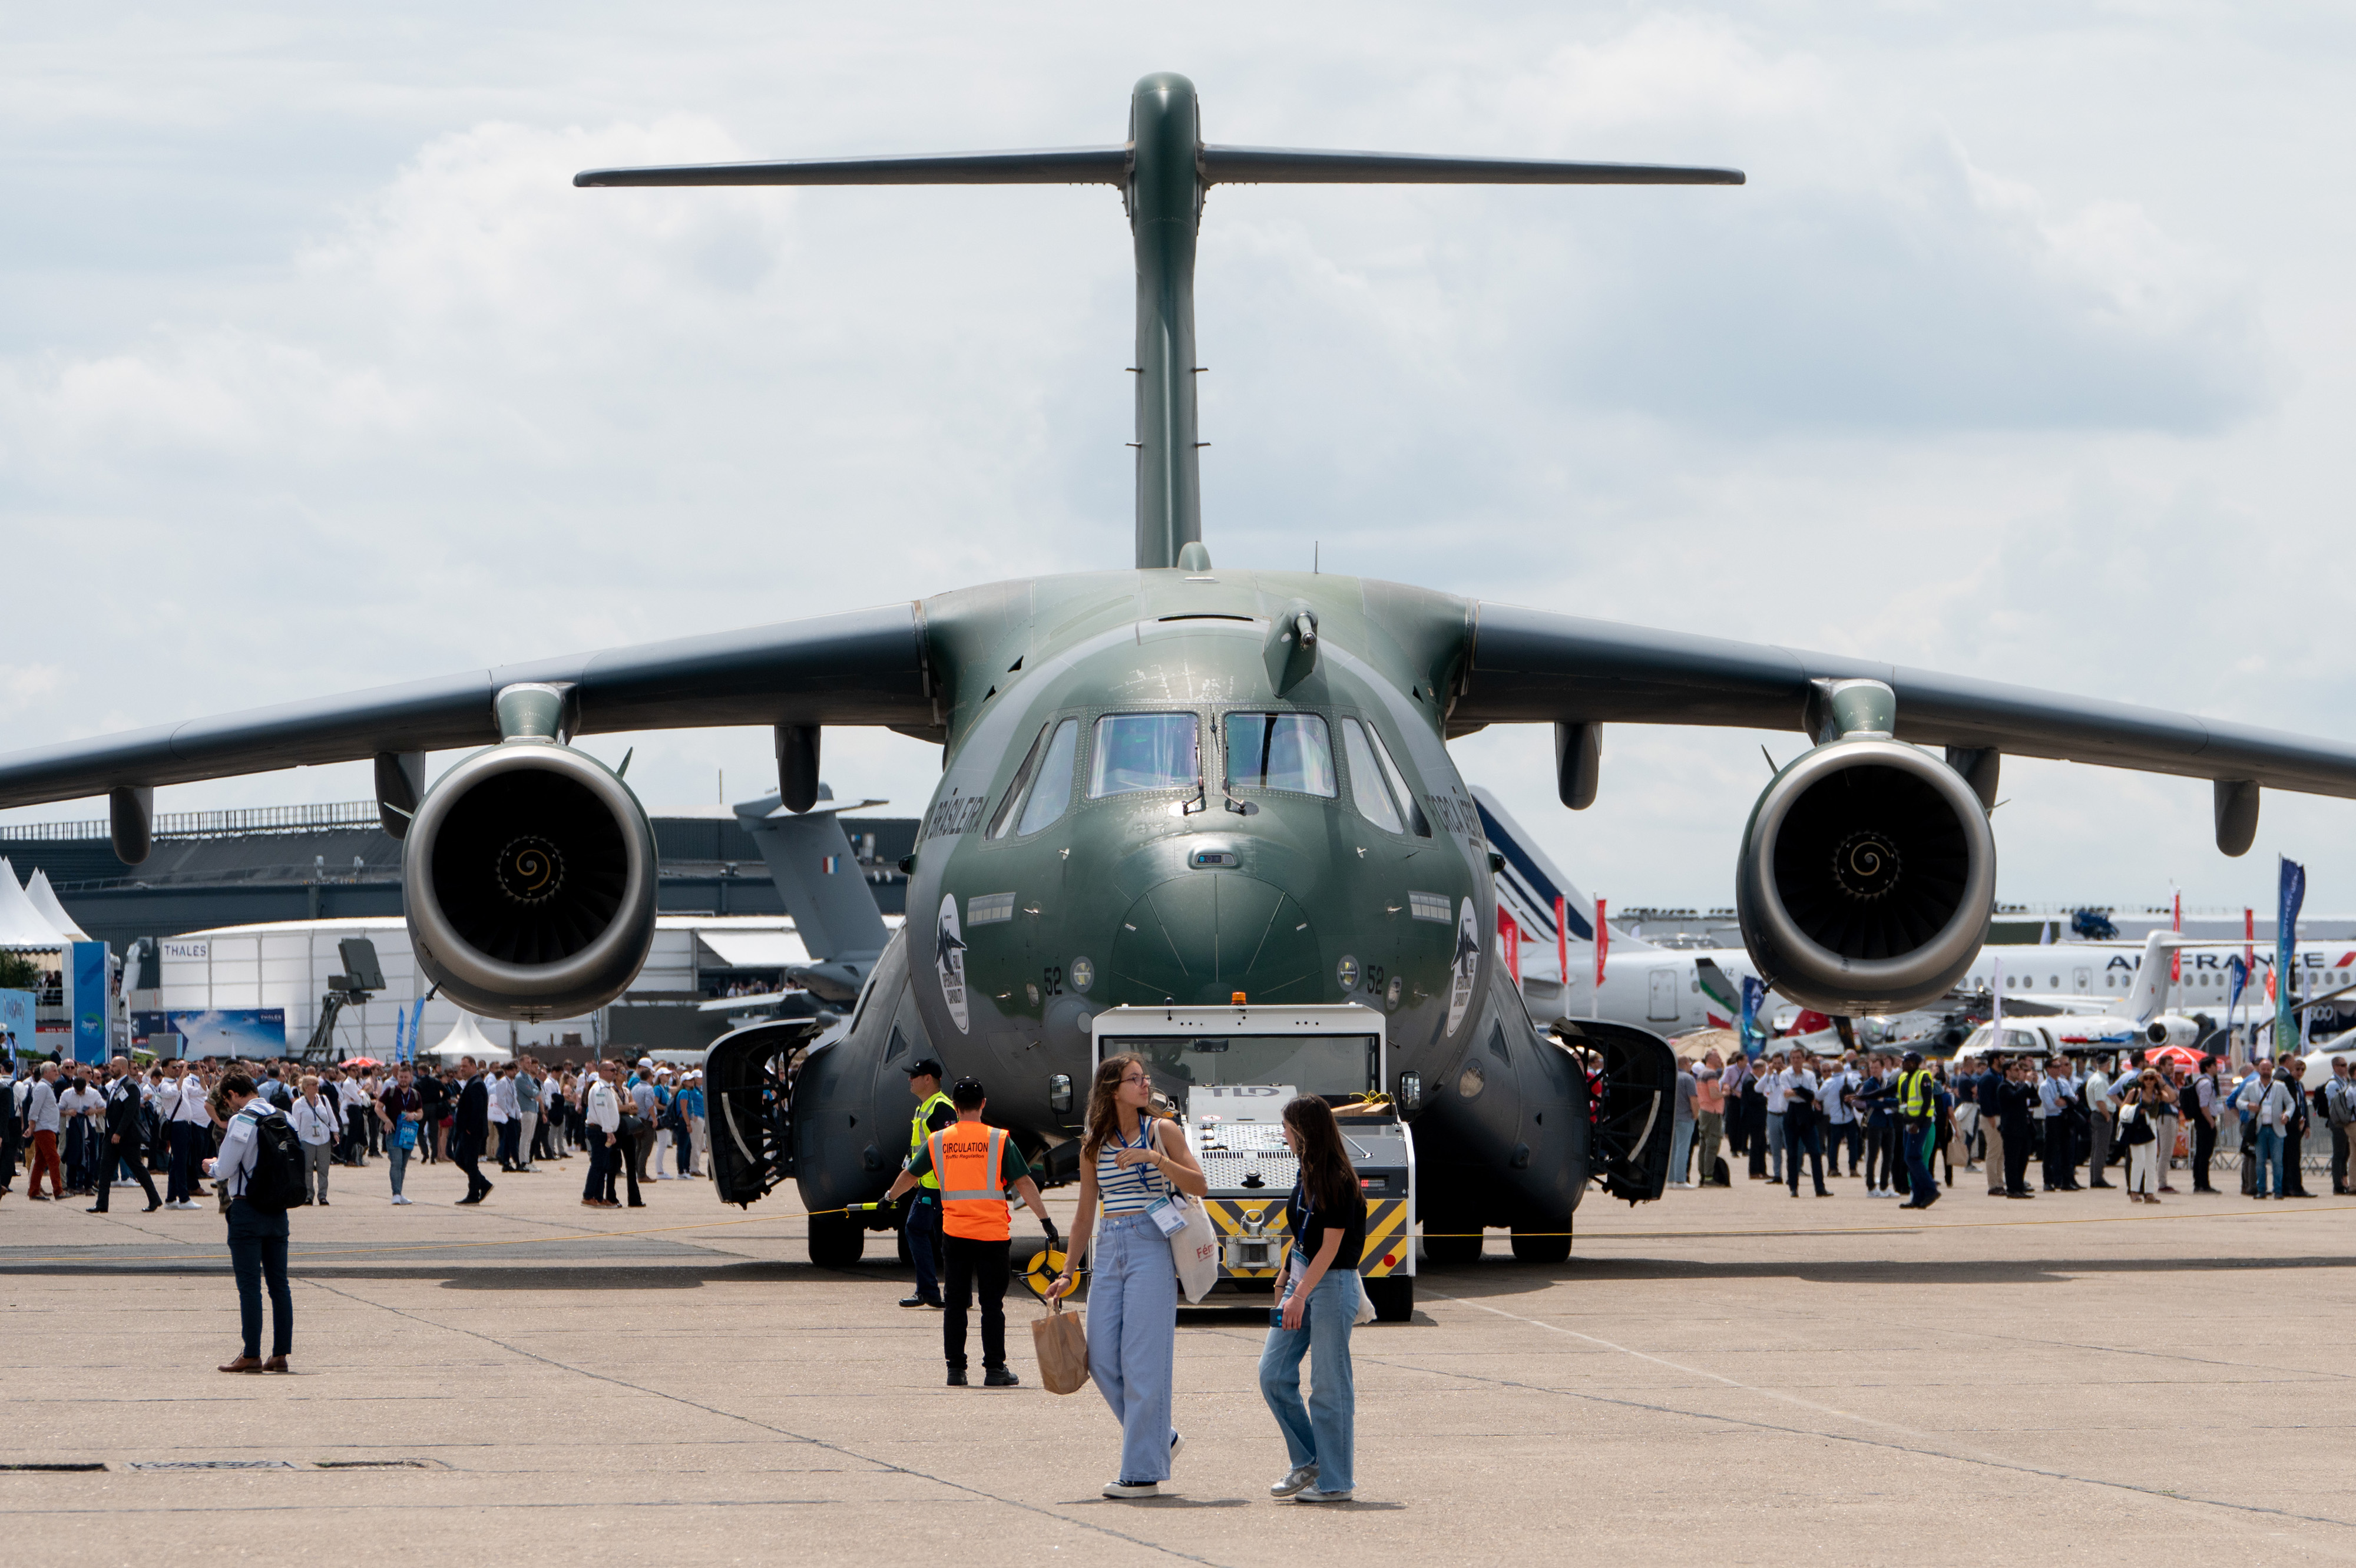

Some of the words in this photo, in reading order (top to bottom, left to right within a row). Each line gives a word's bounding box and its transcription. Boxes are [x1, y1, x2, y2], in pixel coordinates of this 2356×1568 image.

[928, 796, 990, 839] BRASILEIRA
[1423, 795, 1467, 839] FORÇA
[164, 945, 206, 957] THALES
[952, 955, 961, 970] FULL
[2106, 955, 2141, 971] AI
[2181, 953, 2324, 969] FRANE
[1044, 967, 1063, 996] 52
[1367, 965, 1384, 995] 52
[1205, 1087, 1280, 1097] TLD
[942, 1142, 988, 1154] CIRCULATION
